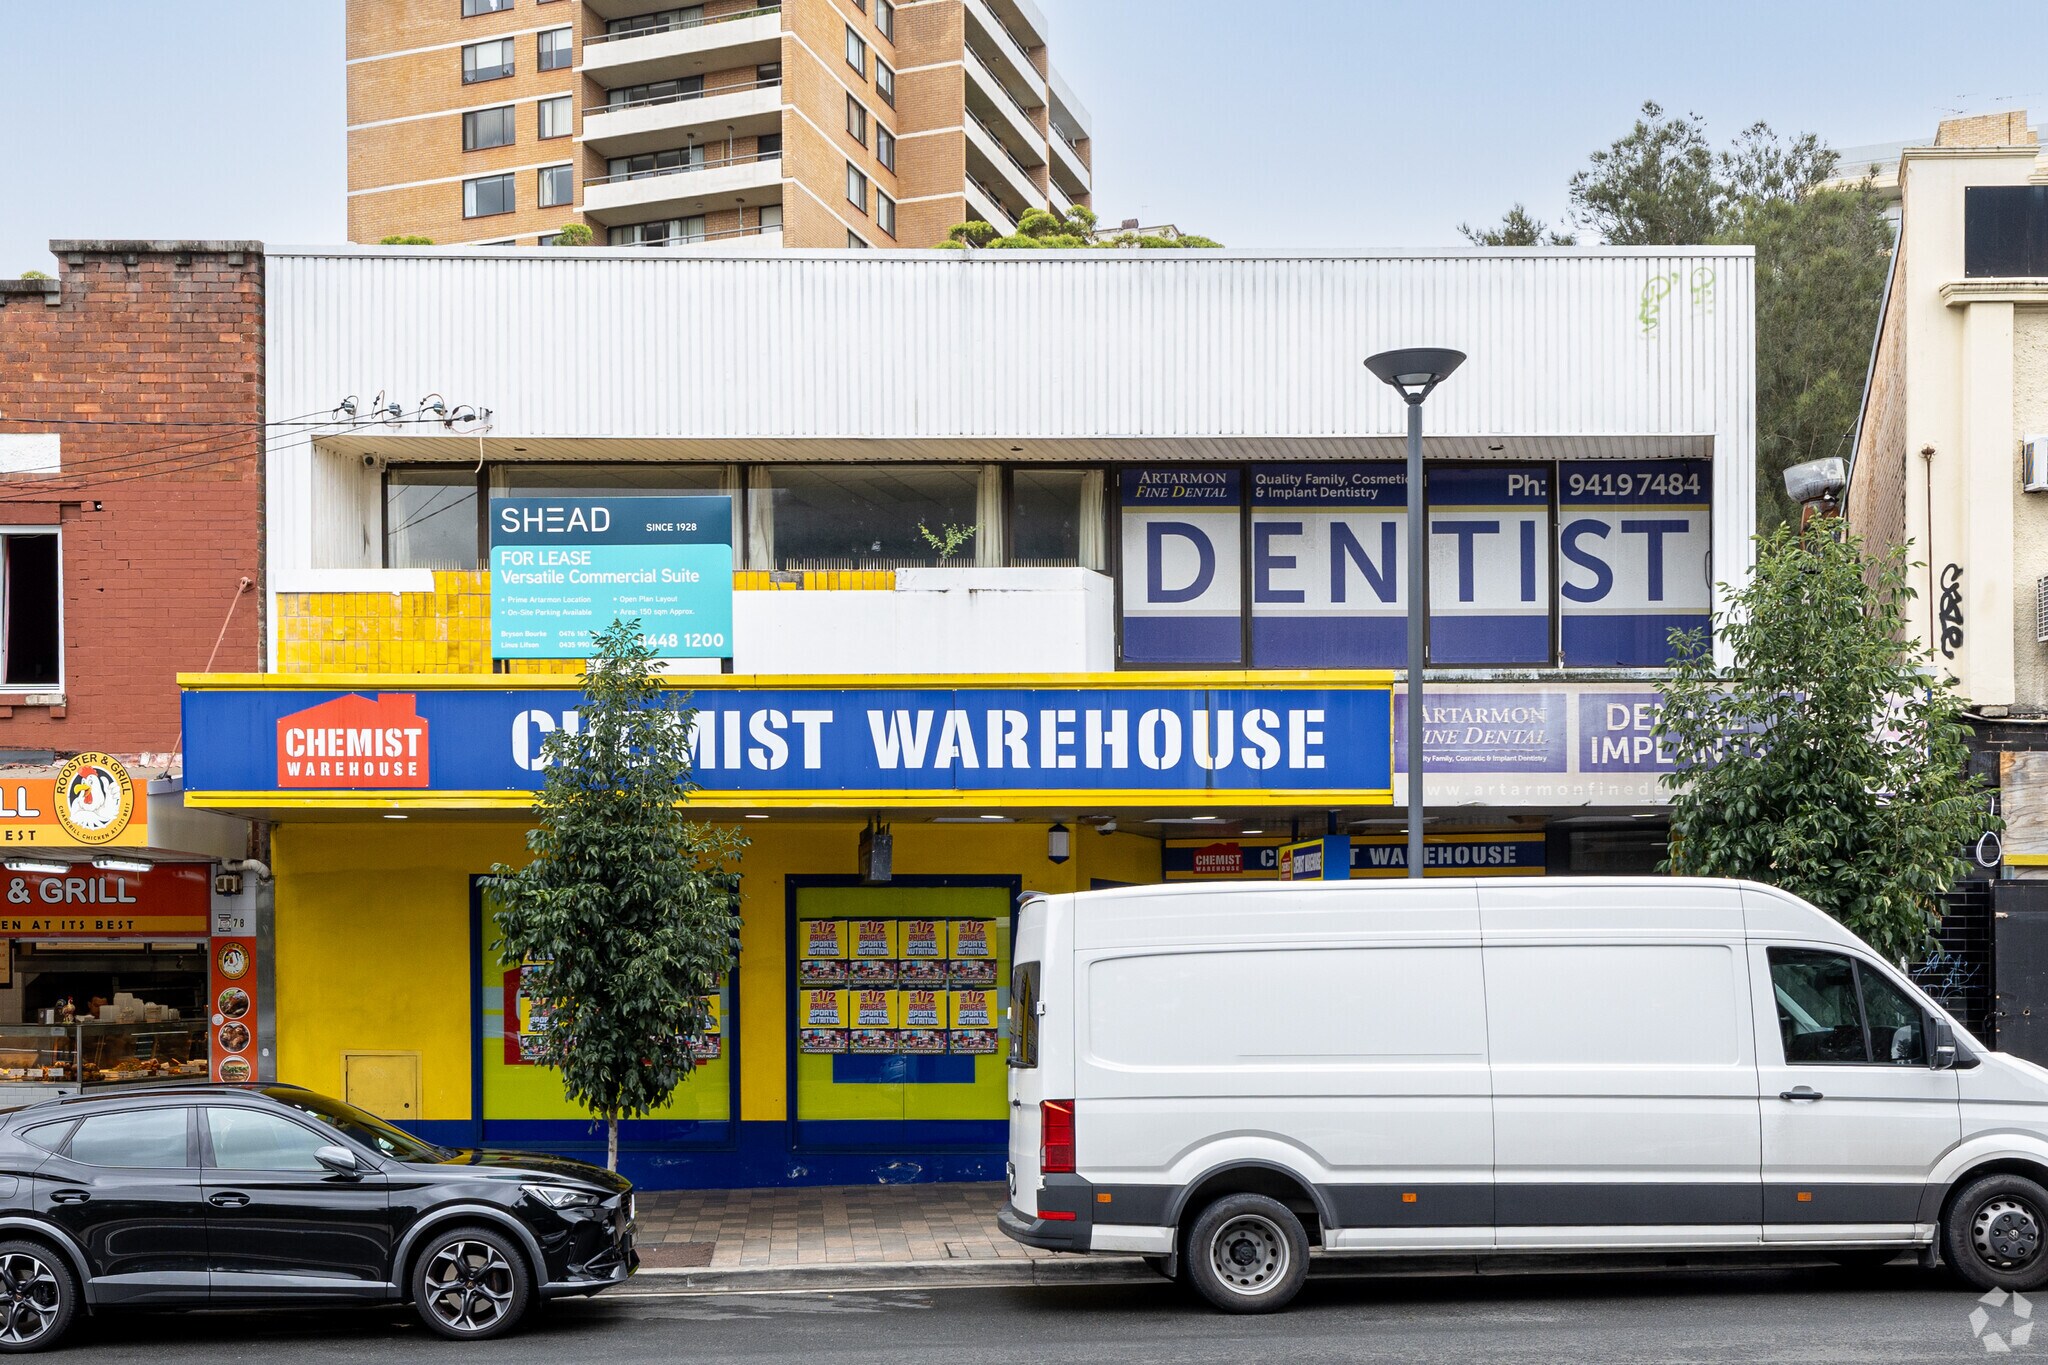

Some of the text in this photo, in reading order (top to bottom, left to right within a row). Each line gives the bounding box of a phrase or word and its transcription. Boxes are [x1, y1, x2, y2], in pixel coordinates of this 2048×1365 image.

[1140, 471, 1227, 484] ARTARMON
[1256, 474, 1302, 486] Quality
[1305, 474, 1349, 486] Family,
[1508, 473, 1700, 496] Ph: 9419 7484
[1136, 486, 1228, 498] FINE DENTAL
[1256, 486, 1378, 500] & Implant Dentistry
[501, 507, 611, 533] SHEAD
[646, 523, 697, 532] SINCE 1928
[501, 551, 592, 566] FOR LEASE
[1146, 518, 1689, 603] DENTIST
[501, 568, 700, 584] Versatile Commercial Suite
[535, 609, 560, 617] Parking
[684, 634, 724, 648] 1200
[1423, 704, 1548, 724] ARTARMON
[286, 728, 422, 758] CHEMIST
[512, 708, 1326, 771] CMIST WAREHOUSE
[1423, 727, 1549, 745] INE DENTAL
[1493, 755, 1517, 763] Implant
[57, 754, 131, 795] ROOSTER & GRILL
[286, 762, 418, 778] WAREHOUSE
[59, 806, 80, 836] CHARGRILL
[5, 830, 36, 840] EST
[1195, 854, 1242, 865] CHEMIST
[1370, 846, 1516, 865] WAEHOUSE
[7, 877, 137, 904] & GRILL
[32, 920, 134, 930] AT ITS BEST
[234, 918, 244, 927] 78
[818, 990, 836, 1002] 1/2
[868, 990, 886, 1002] 1/2
[917, 990, 935, 1003] 1/2
[968, 990, 986, 1003] 1/2
